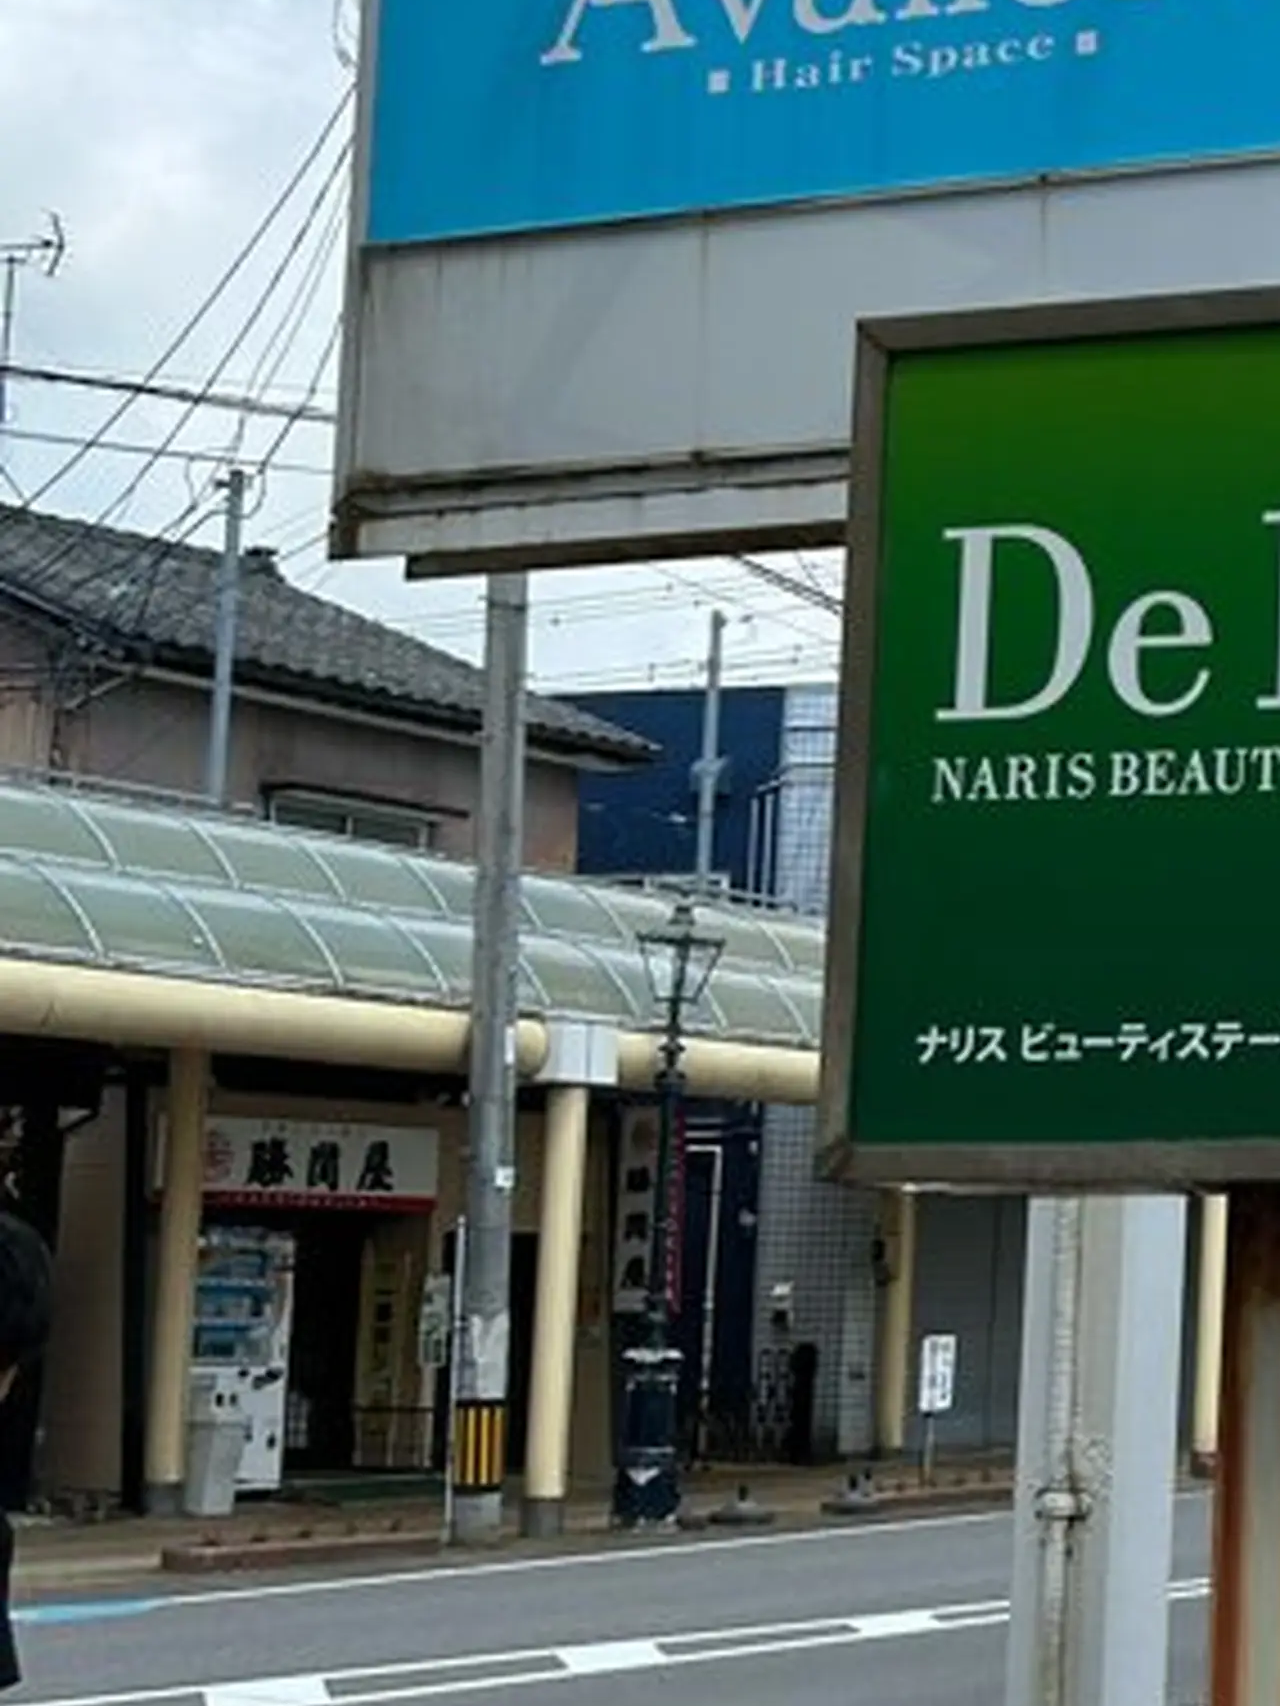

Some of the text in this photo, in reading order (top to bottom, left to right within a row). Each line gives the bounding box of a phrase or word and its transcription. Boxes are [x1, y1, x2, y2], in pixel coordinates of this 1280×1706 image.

[752, 29, 1054, 92] Hair Space
[935, 524, 1214, 721] De
[932, 752, 1096, 802] NARIS
[916, 1024, 1008, 1064] ナリス
